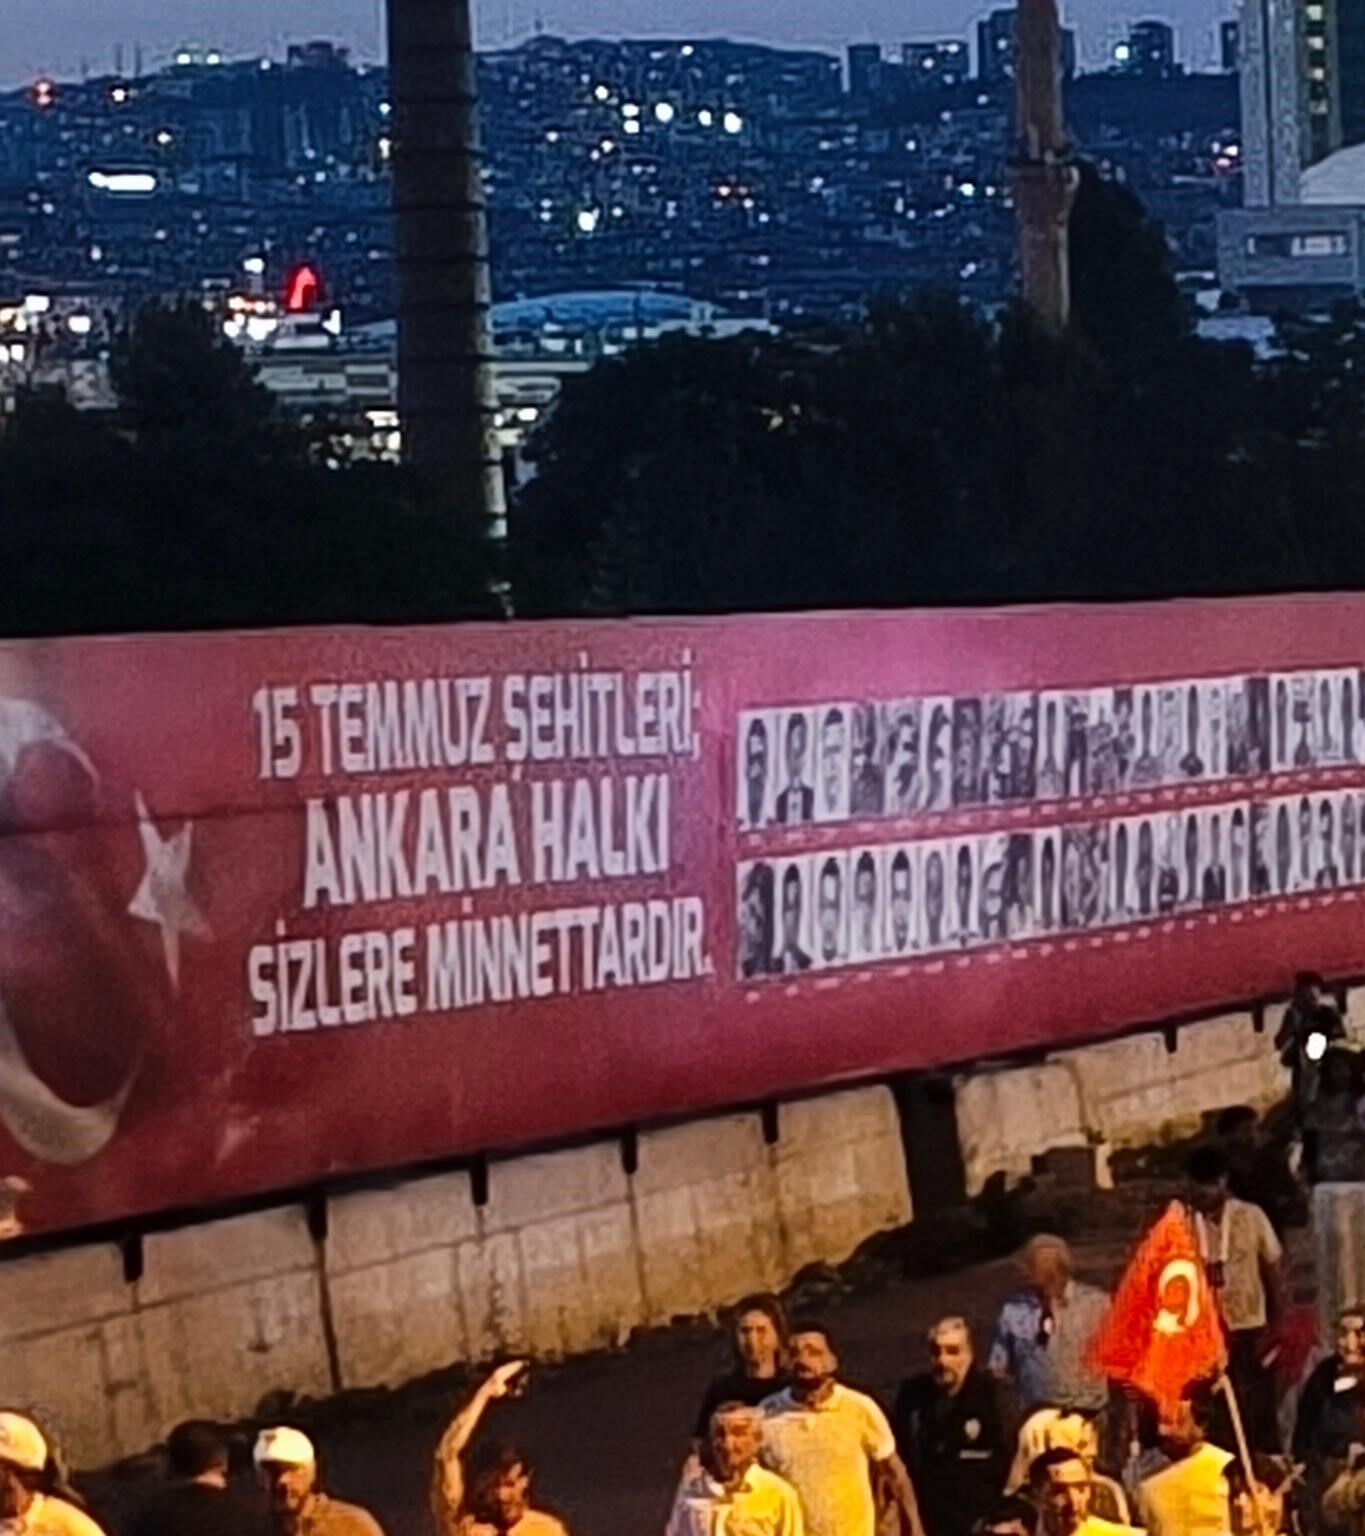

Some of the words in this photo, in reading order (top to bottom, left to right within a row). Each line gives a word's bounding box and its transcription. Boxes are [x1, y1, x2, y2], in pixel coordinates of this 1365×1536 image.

[253, 687, 300, 779] 15
[310, 677, 495, 775] TEMMUZ
[302, 784, 522, 908] ANKARA
[532, 775, 670, 883] HALKI
[248, 918, 418, 1037] SİZLERE
[426, 896, 715, 1012] MİNNETTARDIR.
